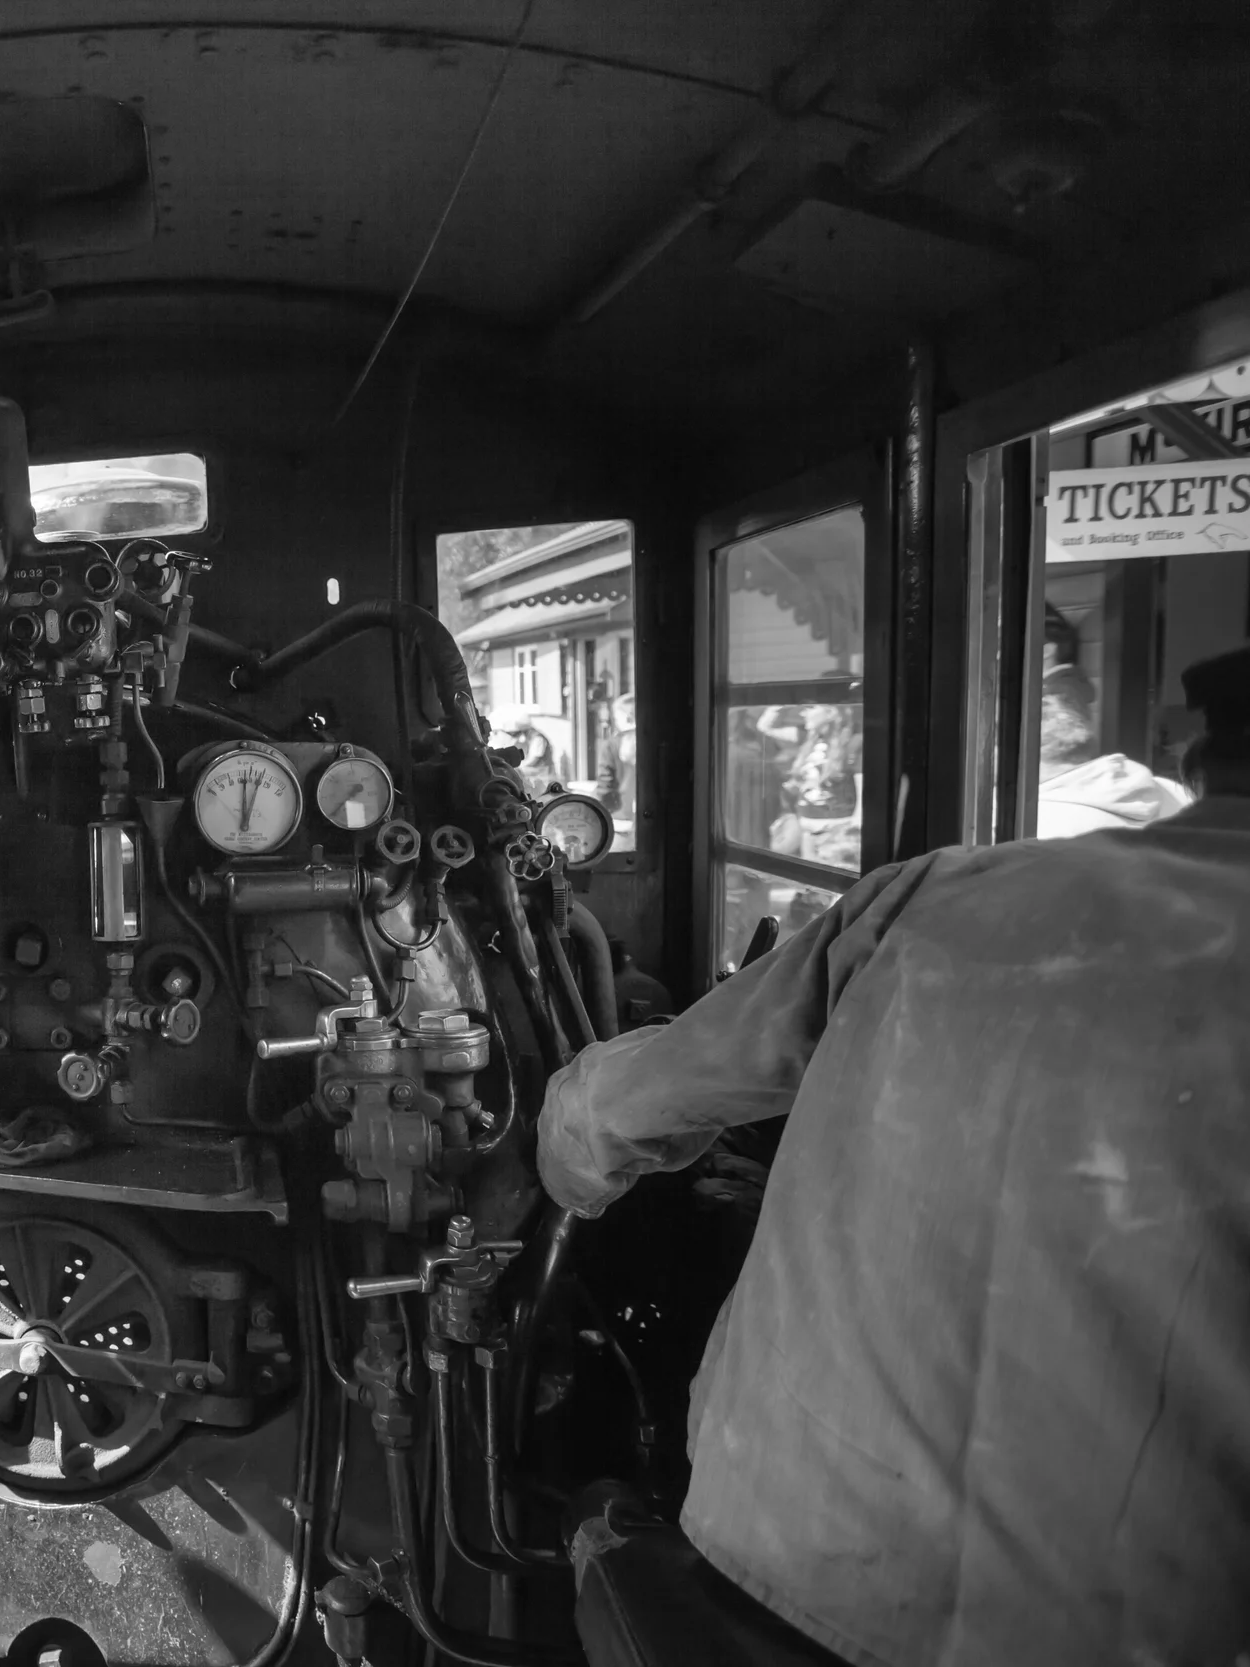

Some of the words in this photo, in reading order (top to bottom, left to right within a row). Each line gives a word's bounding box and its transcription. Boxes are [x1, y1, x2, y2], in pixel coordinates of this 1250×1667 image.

[1058, 474, 1250, 524] TICKETS
[1089, 531, 1140, 546] Booking
[1146, 529, 1185, 542] Office
